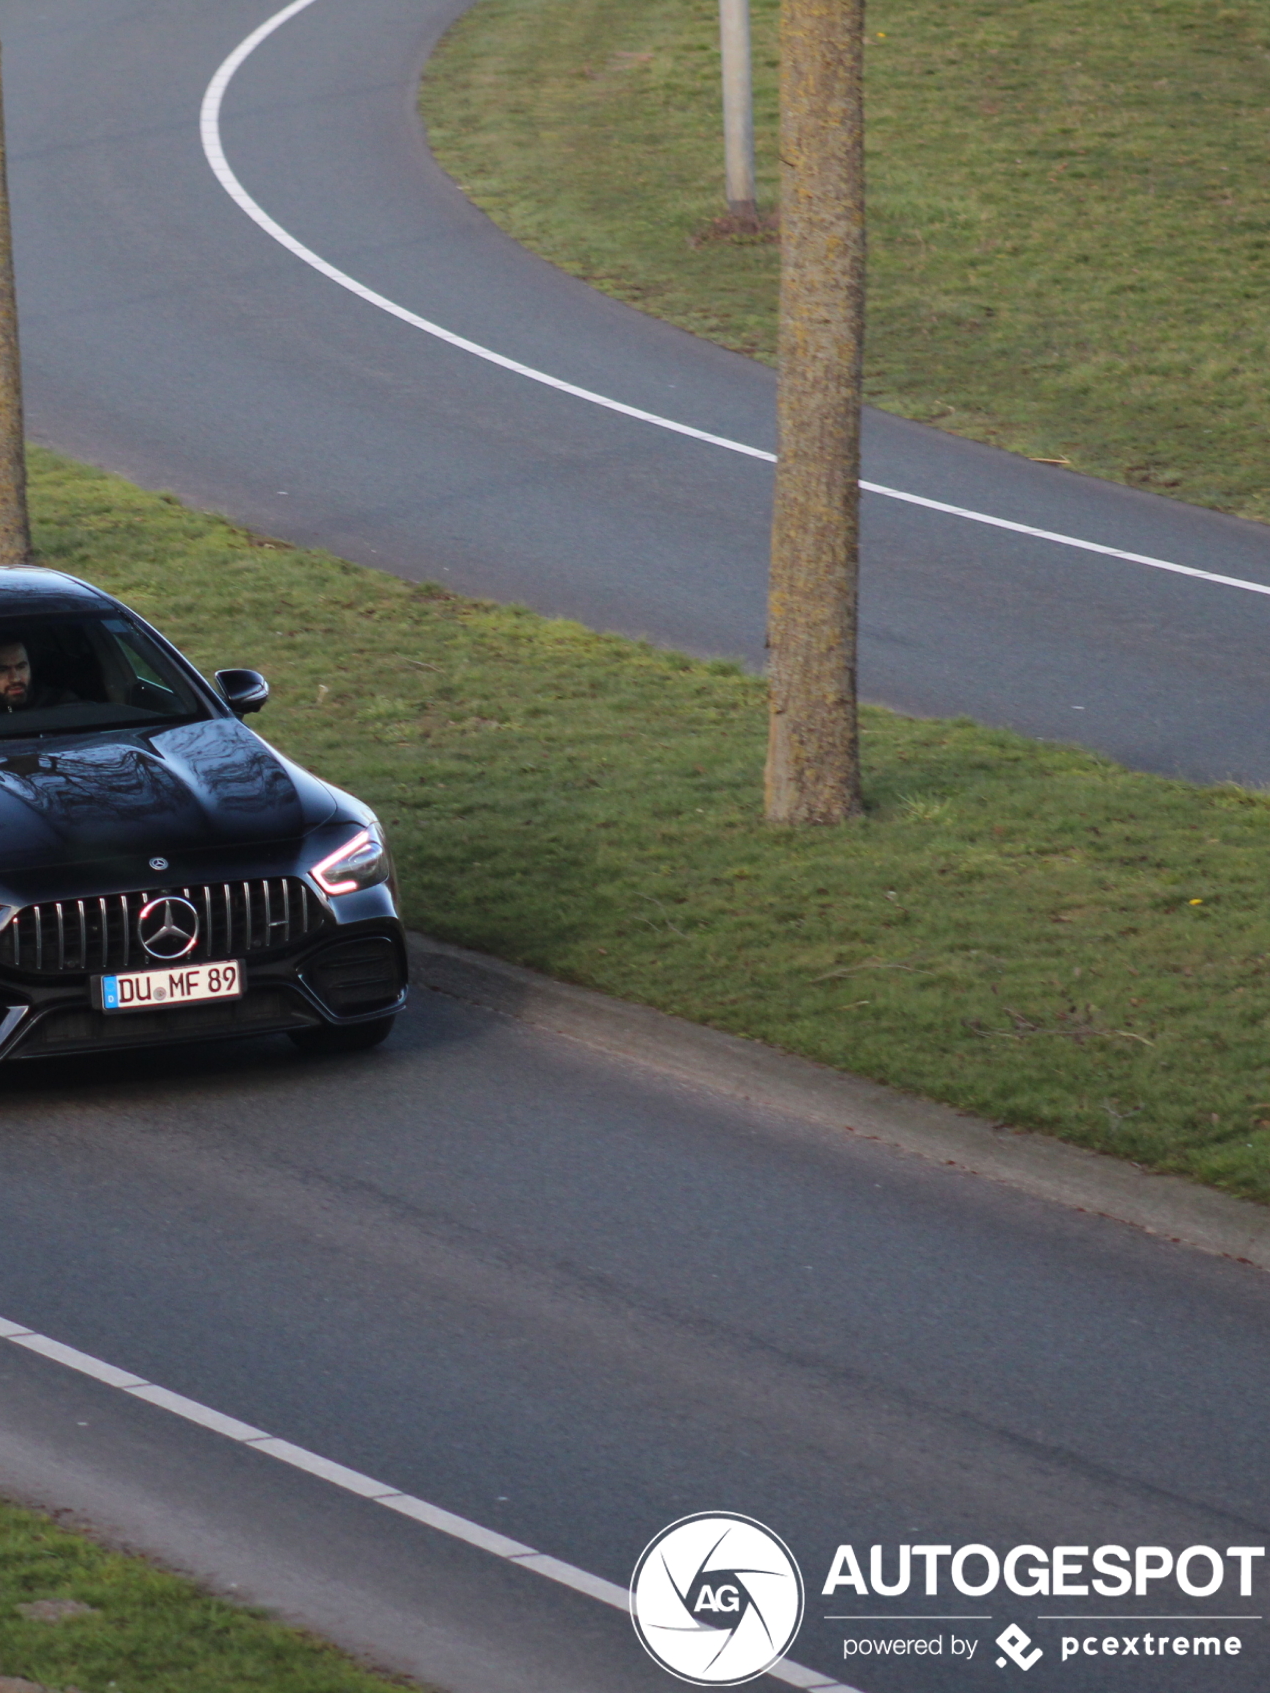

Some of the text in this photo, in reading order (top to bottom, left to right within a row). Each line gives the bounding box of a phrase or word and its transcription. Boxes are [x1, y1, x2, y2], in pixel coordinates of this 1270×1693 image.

[118, 966, 237, 1004] DU MF 89
[107, 995, 115, 1003] D
